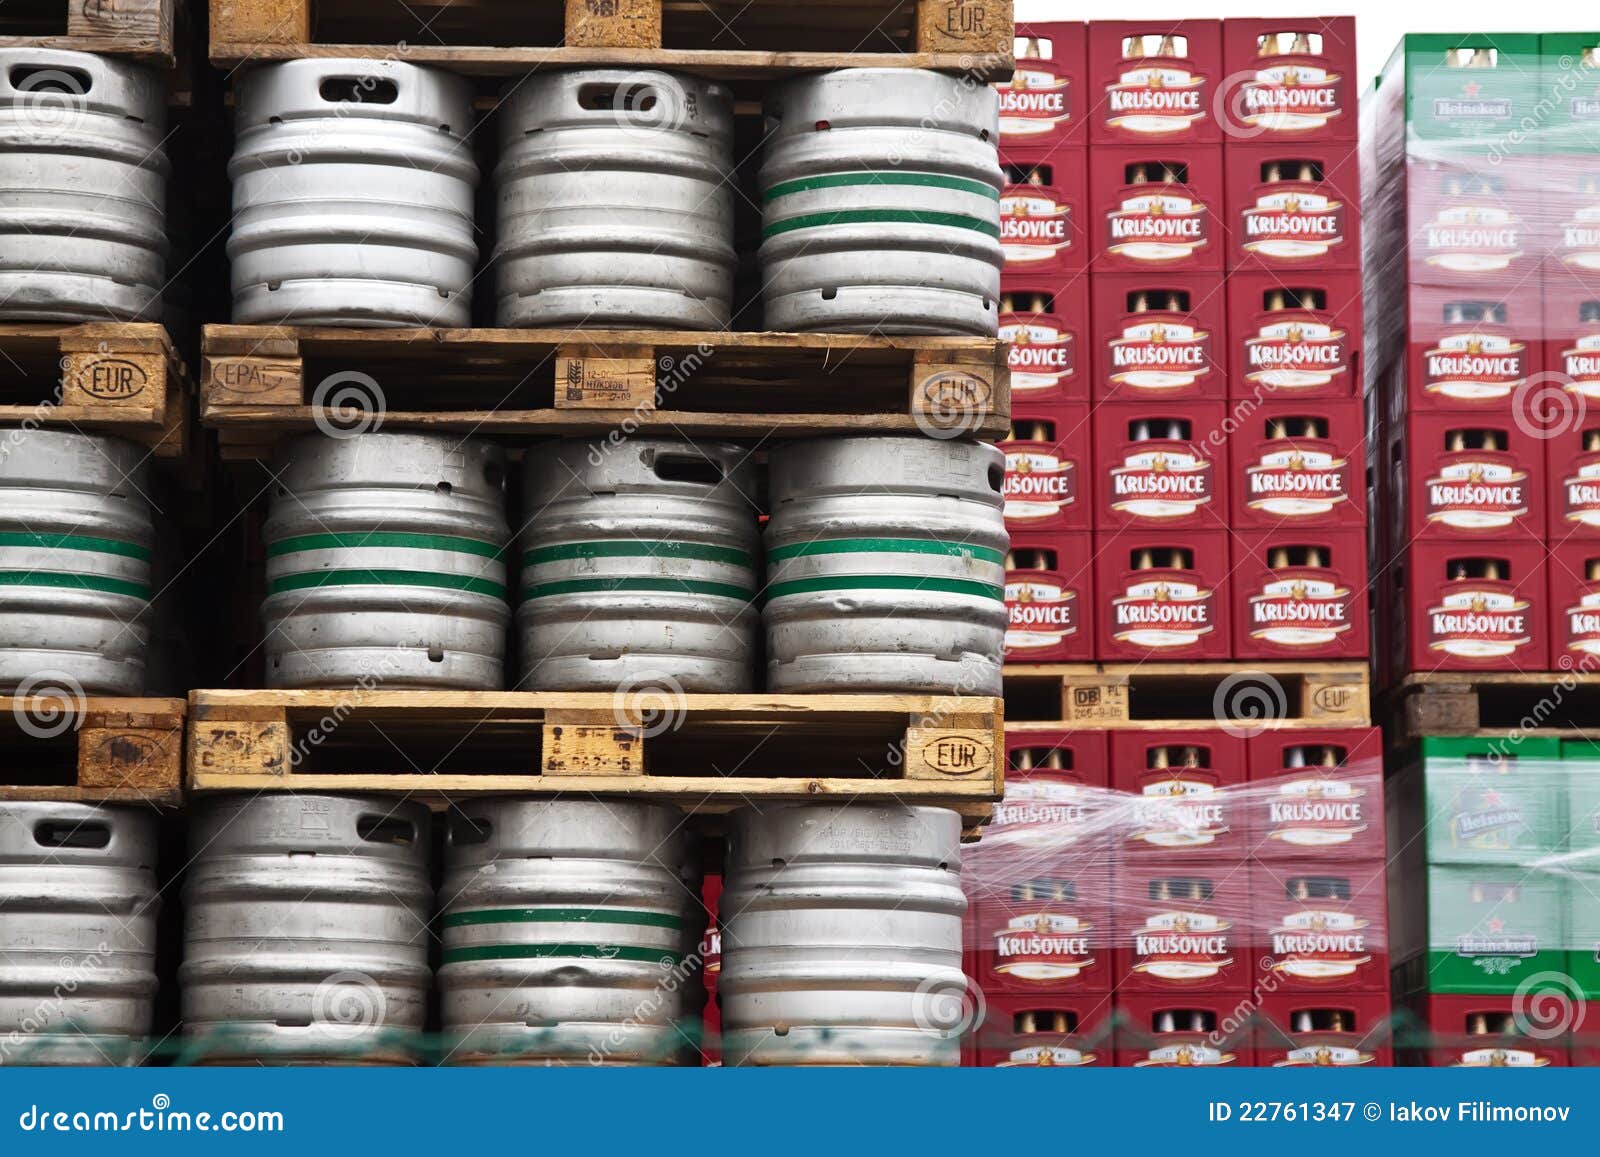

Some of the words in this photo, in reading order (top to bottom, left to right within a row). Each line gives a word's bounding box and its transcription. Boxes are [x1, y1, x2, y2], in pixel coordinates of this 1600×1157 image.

[947, 6, 986, 33] EUR
[998, 89, 1064, 112] UŠOVICE
[1110, 87, 1200, 111] KRUŠOVICE
[1245, 85, 1336, 109] KRUŠOVICE
[1438, 101, 1507, 117] Heineken
[999, 215, 1065, 238] UŠOVICE
[1112, 215, 1201, 238] KRUŠOVICE
[1247, 211, 1337, 235] KRUŠOVICE
[1007, 344, 1067, 366] ŠOVICE
[1113, 342, 1203, 366] KRUŠOVICE
[1250, 340, 1340, 364] KRUŠOVICE
[1429, 354, 1519, 377] KRUŠOVICE
[92, 367, 133, 393] EUR
[939, 379, 977, 403] EUR
[1003, 471, 1068, 494] UŠOVICE
[1115, 471, 1204, 494] KRUŠOVICE
[1252, 470, 1342, 493] KRUŠOVICE
[1430, 482, 1522, 505] KRUŠOVICE
[1117, 600, 1207, 624] KRUŠOVICE
[1254, 599, 1344, 623] KRUŠOVICE
[1432, 611, 1524, 635] KRUŠOVICE
[1078, 690, 1099, 704] DB
[937, 743, 976, 768] EUR
[1270, 799, 1361, 823] KRUŠOVICE
[999, 932, 1089, 956] KRUŠOVICE
[1136, 931, 1227, 956] KRUŠOVICE
[1273, 929, 1365, 954] KRUŠOVICE
